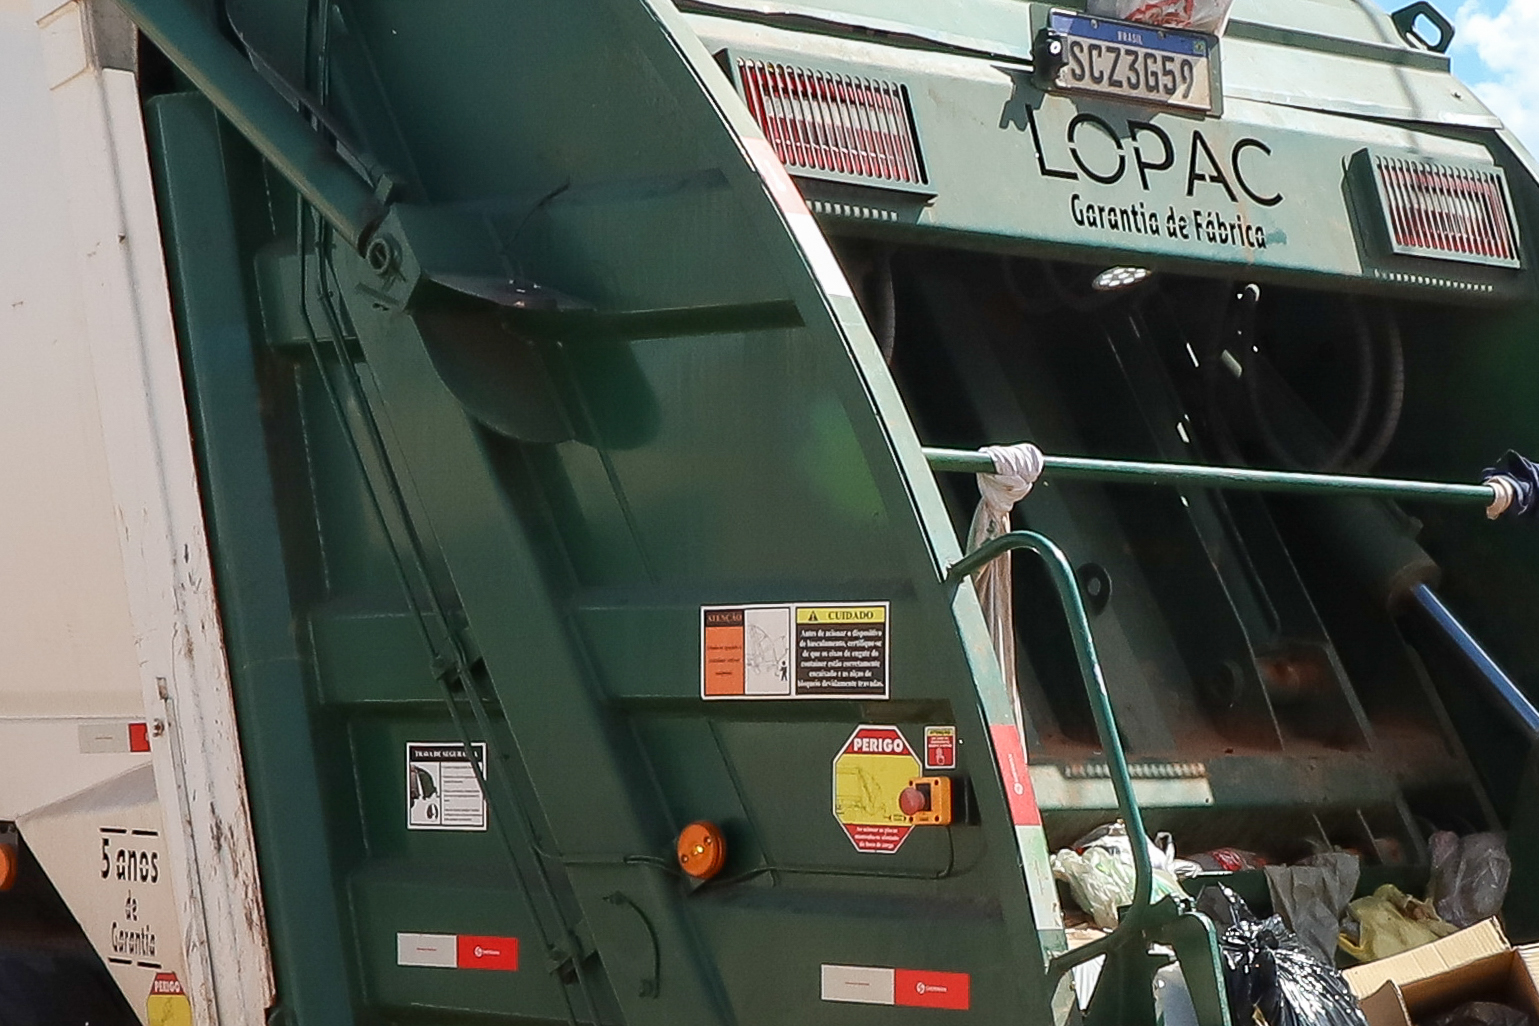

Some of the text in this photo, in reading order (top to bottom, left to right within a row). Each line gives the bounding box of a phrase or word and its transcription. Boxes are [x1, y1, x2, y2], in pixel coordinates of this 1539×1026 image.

[1116, 30, 1143, 46] BRASIL
[1069, 40, 1194, 99] SCZ3G59
[1025, 103, 1284, 207] LOPAC
[1070, 193, 1267, 249] Garantia de Fábrica
[828, 610, 874, 620] CUIDADO
[853, 737, 904, 753] PERIGO
[100, 838, 159, 883] 5 anos
[125, 889, 138, 921] de
[111, 922, 156, 957] Garantia
[154, 980, 181, 993] PERIGO
